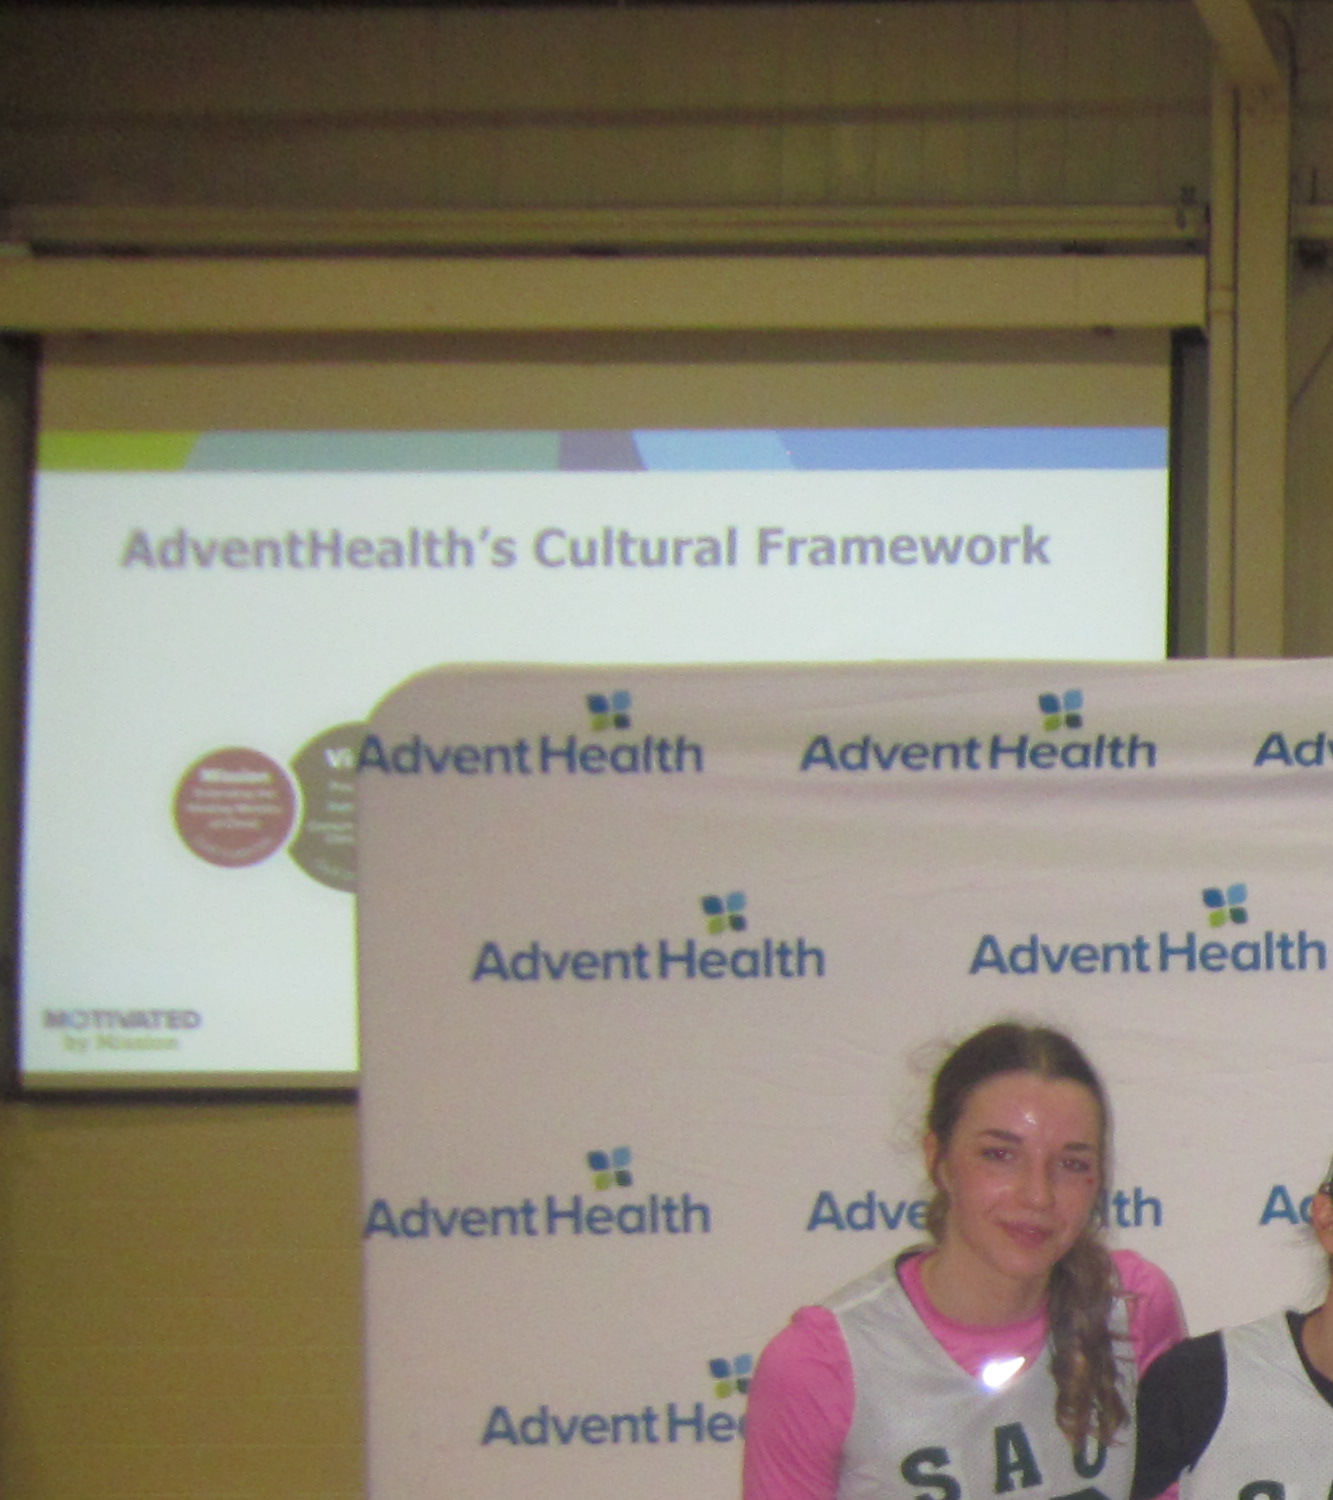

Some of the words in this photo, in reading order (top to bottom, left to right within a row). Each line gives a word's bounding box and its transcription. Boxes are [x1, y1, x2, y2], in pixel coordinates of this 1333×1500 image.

[533, 525, 737, 568] Cultural
[756, 523, 1051, 567] Framework
[356, 733, 703, 775] AdventHealth
[800, 734, 1157, 771] AdventHealth
[471, 938, 825, 981] AdventHealth
[970, 932, 1326, 974] AdventHealth
[362, 1193, 710, 1240] AdventHealth
[480, 1402, 746, 1445] AdventHe
